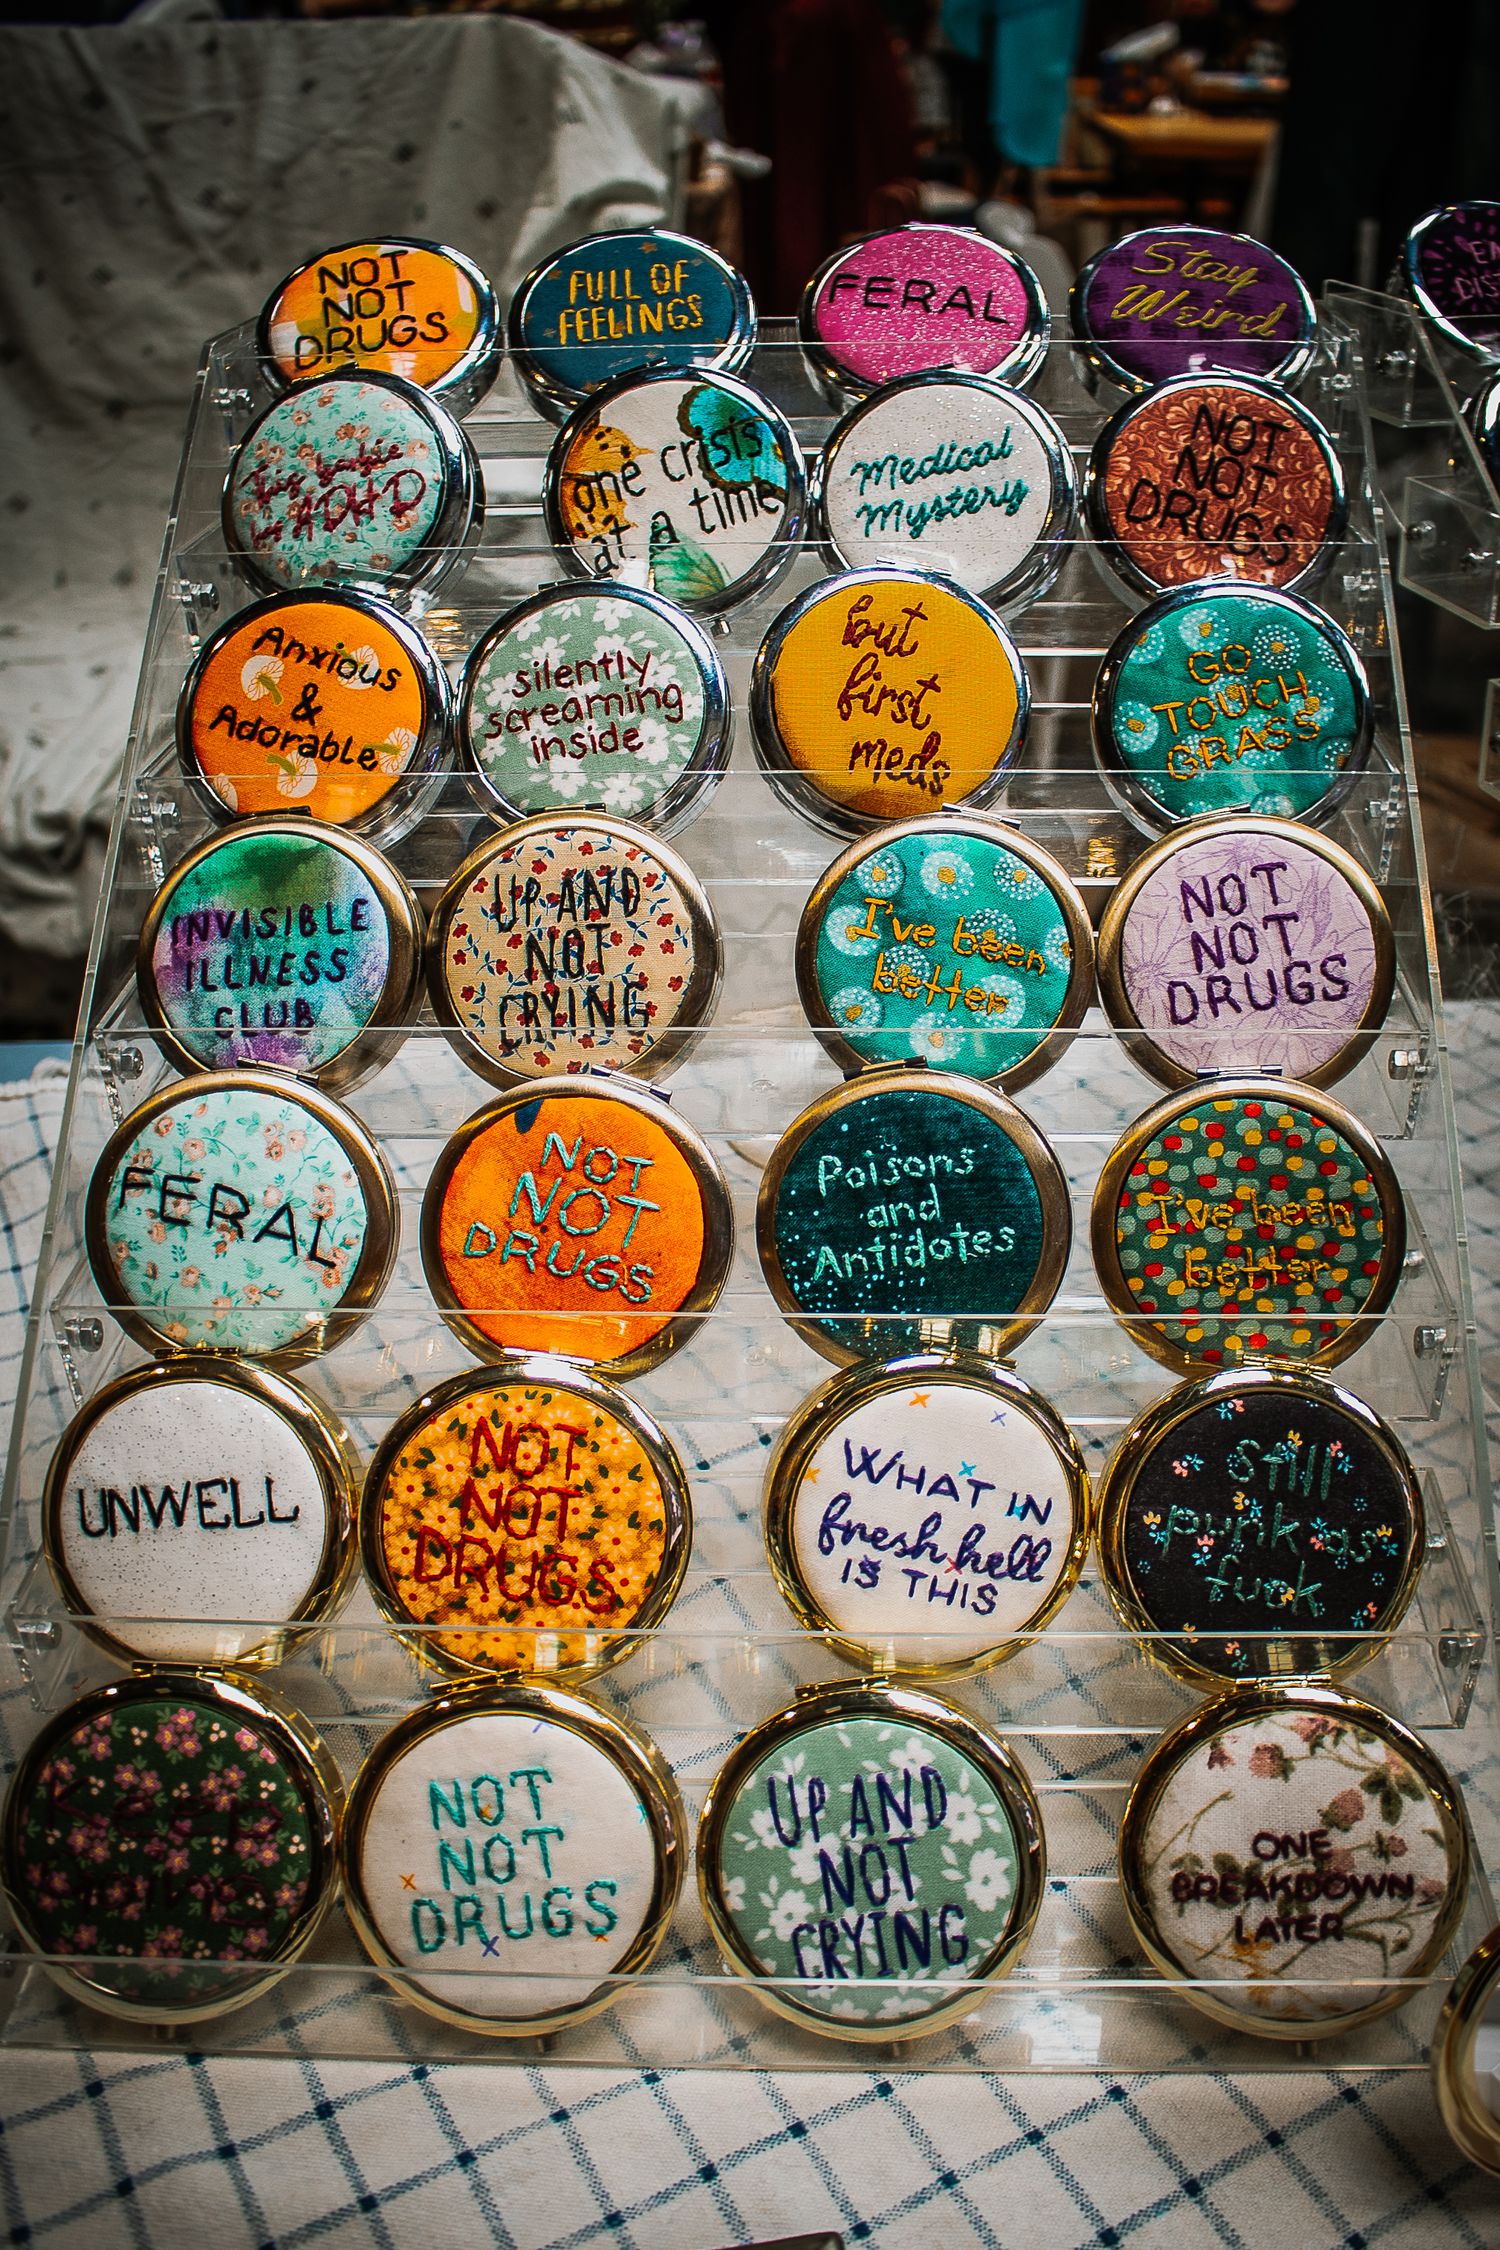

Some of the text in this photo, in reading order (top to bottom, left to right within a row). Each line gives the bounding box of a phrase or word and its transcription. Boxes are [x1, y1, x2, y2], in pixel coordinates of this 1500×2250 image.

[318, 250, 408, 294] NOT
[569, 259, 690, 305] FULL OF
[828, 273, 1010, 323] FERAL
[1131, 241, 1259, 296] Stay
[322, 280, 415, 327] NOT
[559, 294, 704, 345] FEELINGS
[1111, 284, 1288, 337] Weird
[295, 311, 449, 369] DRUGS
[1190, 403, 1291, 460] NOT
[573, 416, 763, 513] one crisis
[1173, 445, 1278, 506] NOT
[292, 468, 427, 541] ADHD
[591, 480, 780, 574] at a time
[1126, 478, 1295, 566] DRUGS
[841, 594, 929, 657] but
[252, 626, 403, 692] Anxious
[513, 650, 652, 697] silently
[1187, 644, 1252, 684] GO
[290, 681, 324, 727] &
[484, 682, 684, 739] screaming
[837, 651, 942, 730] first
[1150, 669, 1309, 735] TOUCH
[208, 704, 380, 771] Adorable
[531, 721, 645, 764] inside
[1167, 709, 1321, 780] GRASS
[171, 899, 370, 944] INVISIBLE
[494, 866, 641, 933] UP AND
[1180, 861, 1288, 923] NOT
[525, 922, 612, 985] NOT
[852, 897, 1047, 976] I've been
[1190, 911, 1301, 974] NOT
[186, 947, 350, 992] ILLNESS
[872, 953, 1009, 1016] better
[1167, 953, 1351, 1027] DRUGS
[214, 999, 316, 1040] CLUB
[500, 980, 651, 1049] CRYING
[542, 1132, 656, 1193] NOT
[818, 1150, 975, 1197] Poisons
[116, 1166, 338, 1270] FERAL
[509, 1172, 661, 1249] NOT
[866, 1183, 941, 1227] and
[1153, 1187, 1351, 1234] I've been
[463, 1221, 656, 1302] DRUGS
[813, 1222, 1016, 1280] Antidotes
[1184, 1245, 1331, 1288] better
[470, 1416, 590, 1481] NOT
[77, 1476, 301, 1538] UNWELL
[459, 1475, 585, 1543] NOT
[844, 1438, 1053, 1526] WHAT IN
[818, 1491, 1052, 1583] fresh hell
[1162, 1501, 1378, 1563] punk as
[413, 1525, 617, 1613] DRUGS
[841, 1556, 999, 1616] IS THIS
[429, 1766, 554, 1831] NOT
[768, 1765, 948, 1848] UP AND
[438, 1825, 565, 1891] NOT
[818, 1835, 917, 1914] NOT
[1252, 1828, 1334, 1862] ONE
[410, 1879, 619, 1953] DRUGS
[1171, 1871, 1414, 1903] BREAKDOWN
[791, 1903, 969, 1989] CRYING
[1234, 1912, 1345, 1945] LATER
